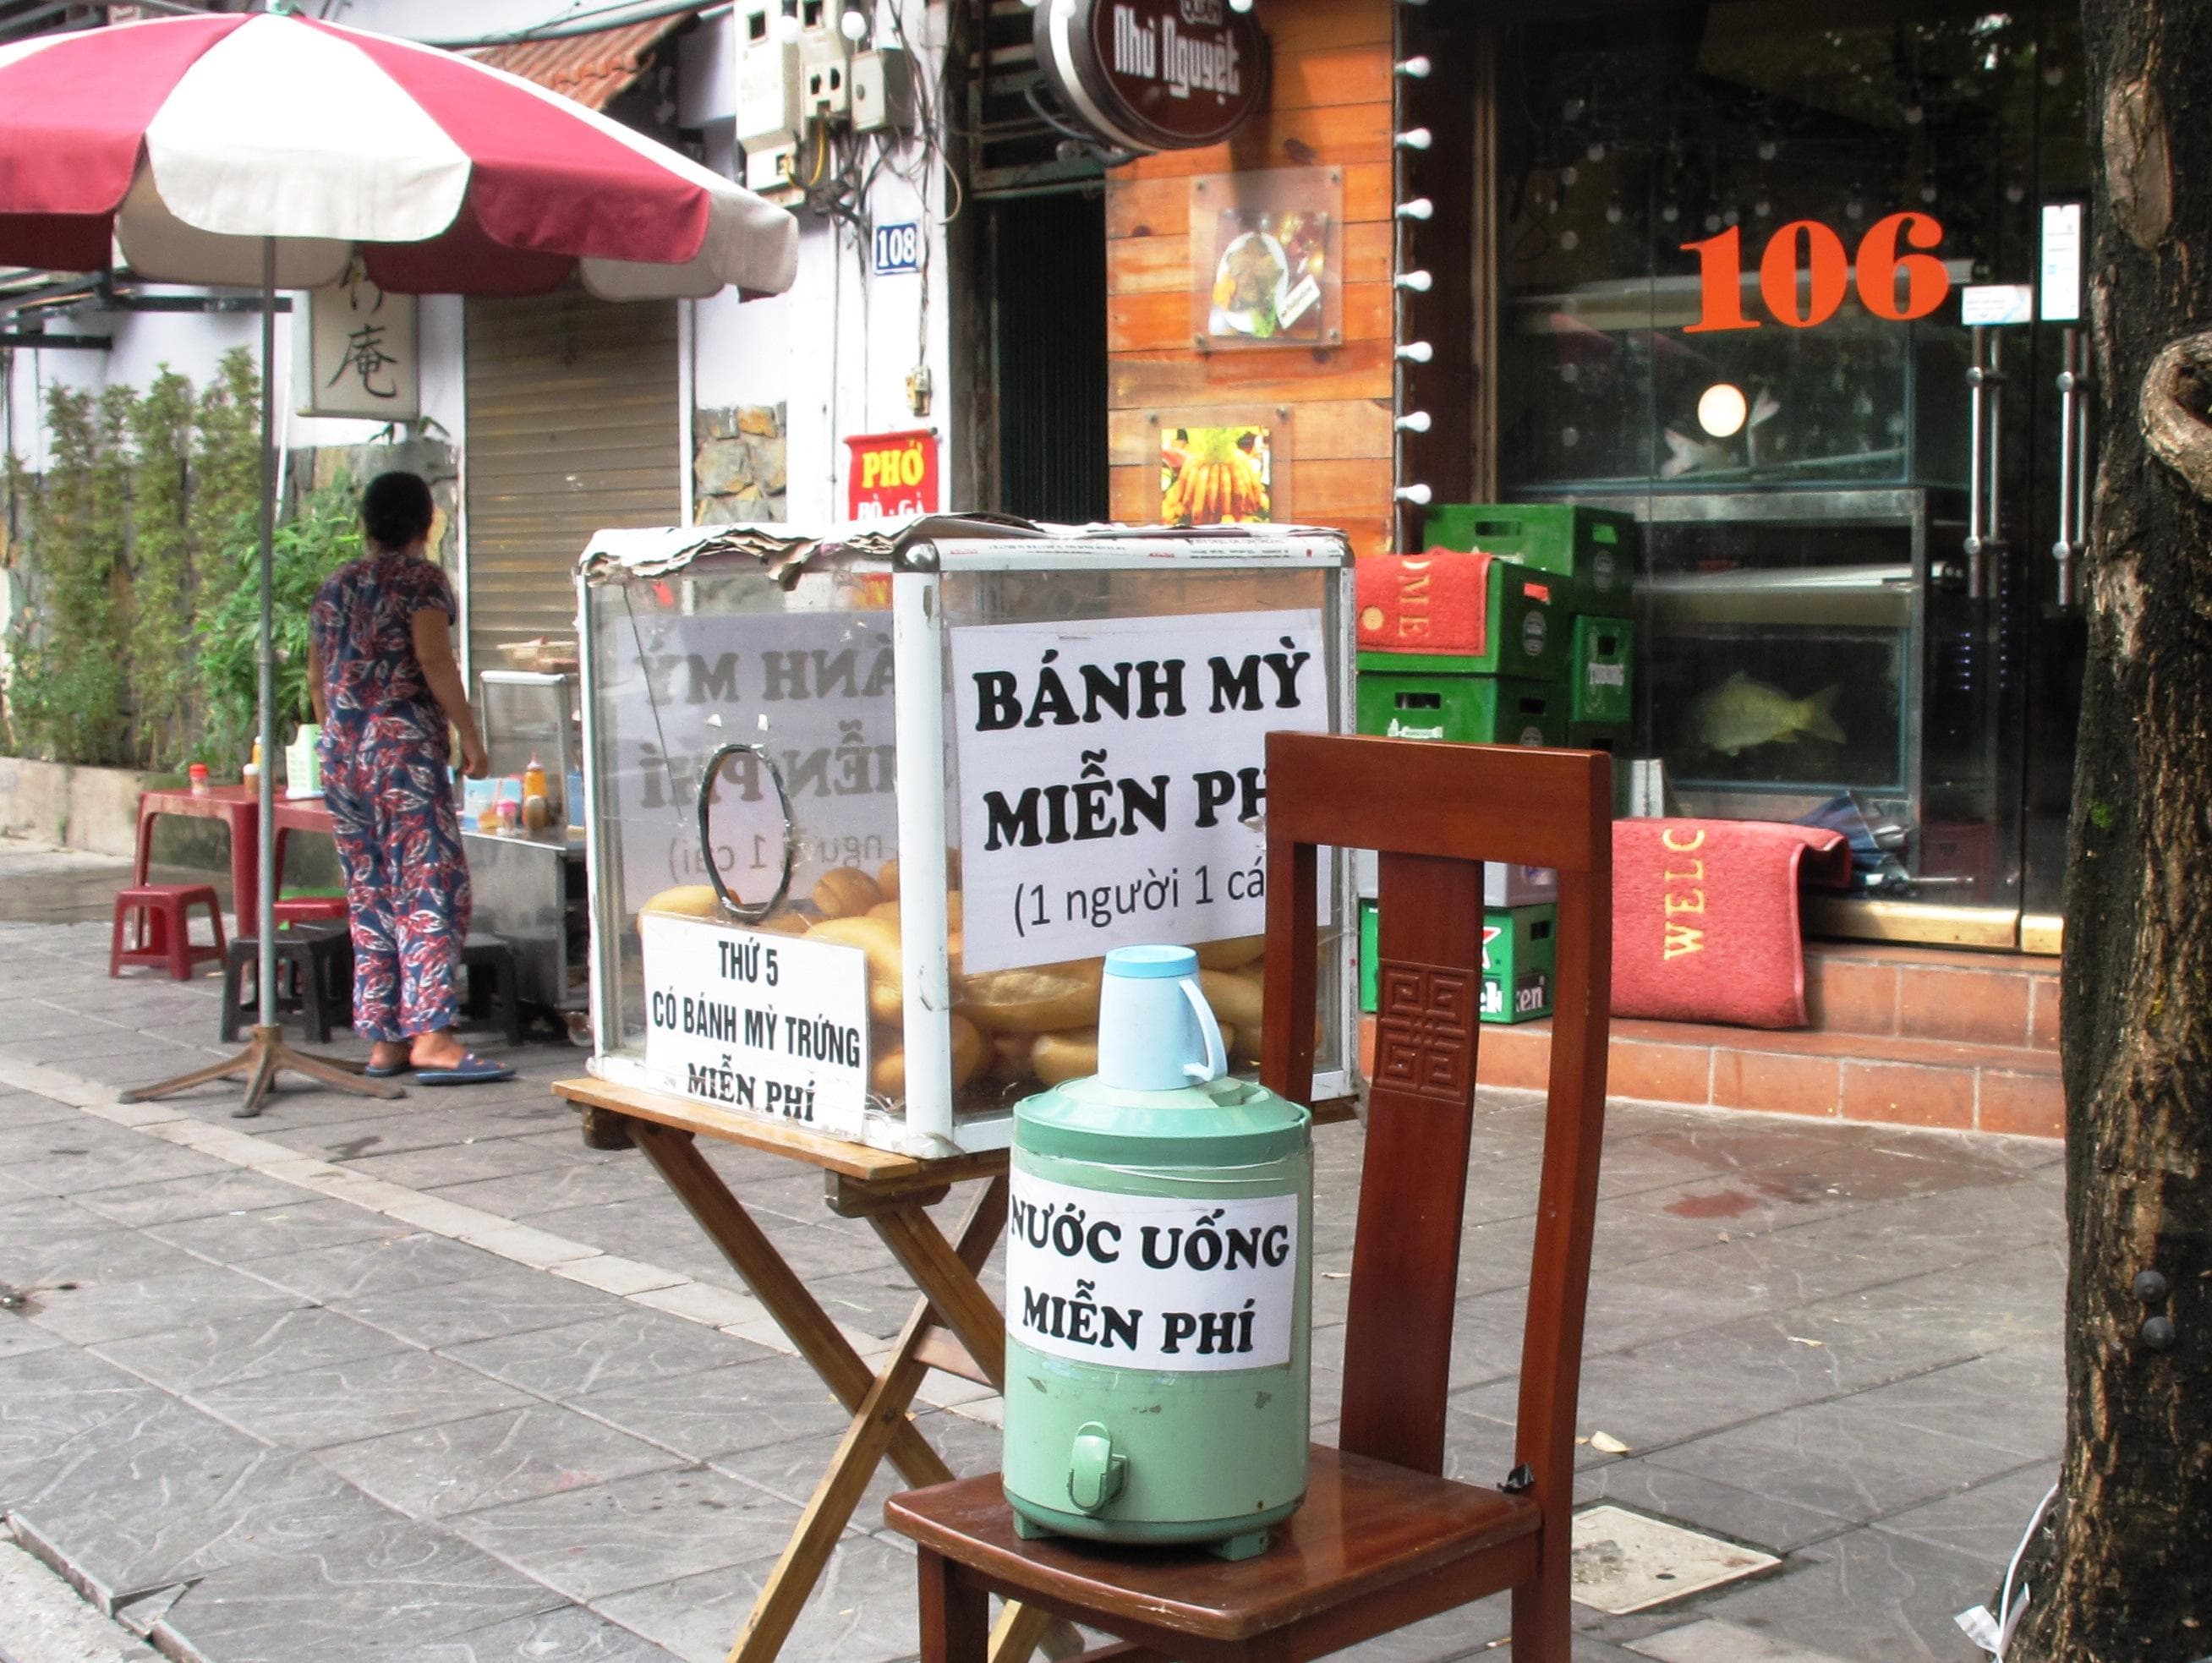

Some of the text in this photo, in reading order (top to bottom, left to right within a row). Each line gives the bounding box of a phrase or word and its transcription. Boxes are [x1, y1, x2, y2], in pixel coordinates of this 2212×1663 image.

[879, 227, 915, 267] 108
[1679, 211, 1950, 333] 106
[862, 439, 924, 489] PHỞ
[972, 636, 1311, 731] BÁNH MỲ
[983, 748, 1267, 851] MIỄN PH
[1014, 856, 1265, 937] (1 người 1 cá
[1662, 828, 1706, 960] WELC
[719, 937, 778, 987] THỨ 5
[653, 986, 860, 1068] CÓ BÁNH MỲ TRỨNG
[687, 1053, 815, 1122] MIỄN PHÍ
[1011, 1194, 1289, 1271] NƯỚC UỐNG
[1022, 1278, 1256, 1354] MIỄN PHÍ
